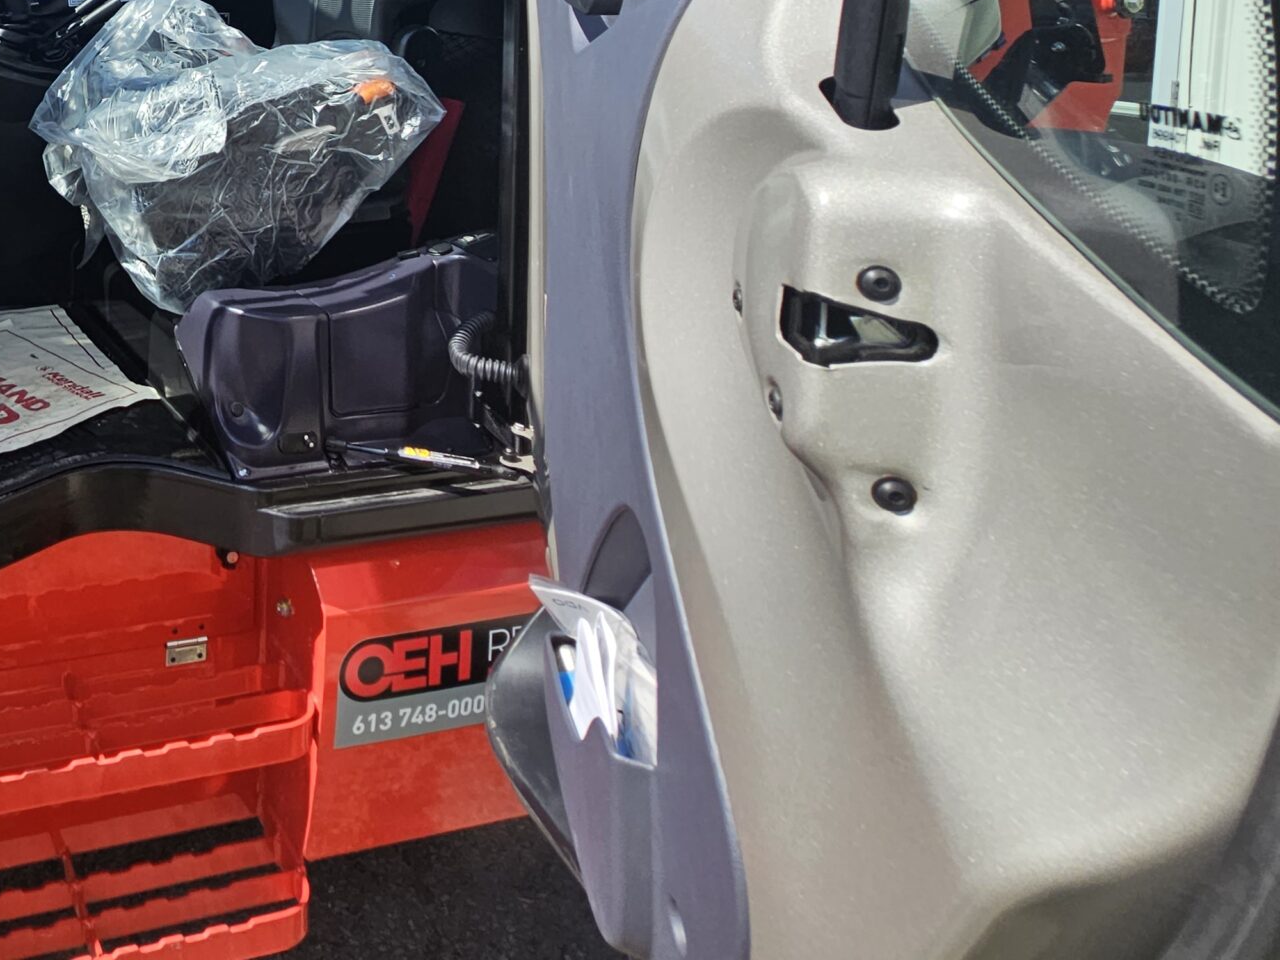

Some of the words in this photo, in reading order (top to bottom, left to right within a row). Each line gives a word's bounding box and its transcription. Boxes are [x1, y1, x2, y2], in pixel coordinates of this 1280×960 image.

[47, 371, 106, 398] Kendall
[345, 630, 473, 697] OEH
[352, 711, 393, 735] 613
